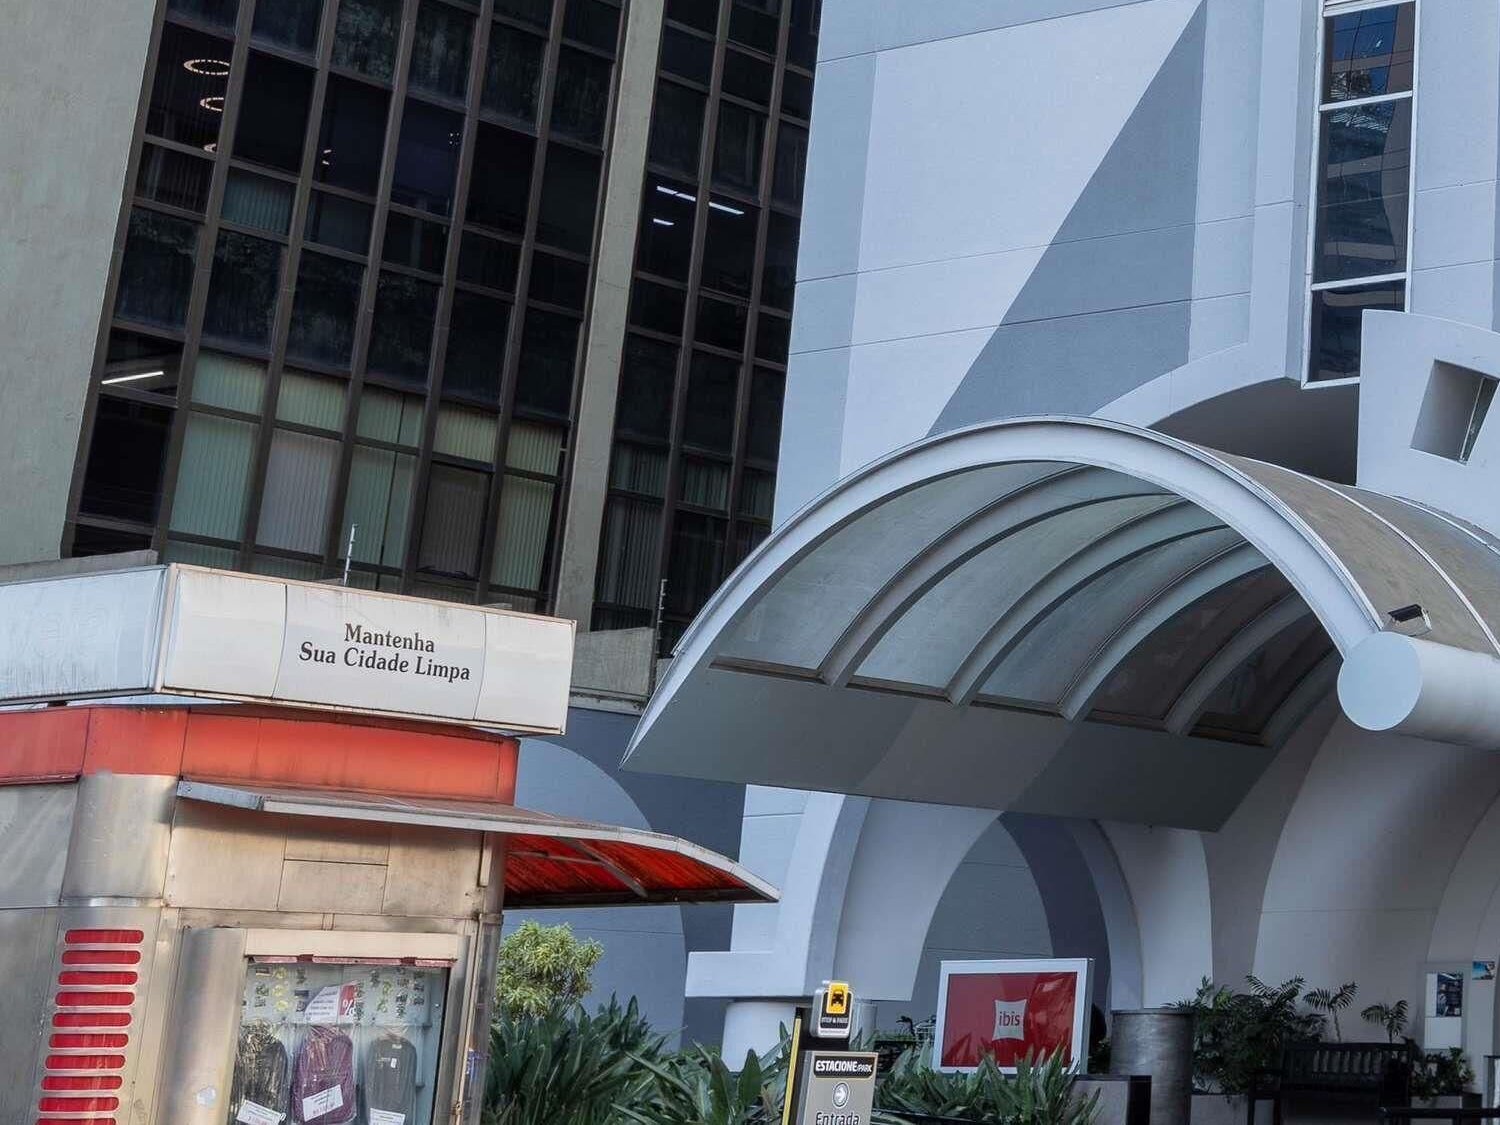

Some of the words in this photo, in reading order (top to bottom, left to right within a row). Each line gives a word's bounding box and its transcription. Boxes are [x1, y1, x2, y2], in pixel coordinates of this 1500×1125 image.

[344, 623, 435, 653] Mantenha
[299, 641, 336, 664] Sua
[344, 647, 409, 673] Cidade
[415, 656, 470, 683] Limpa
[999, 1011, 1020, 1026] ibis
[815, 1060, 858, 1072] ESTACIONE
[816, 1111, 860, 1125] Entrada
